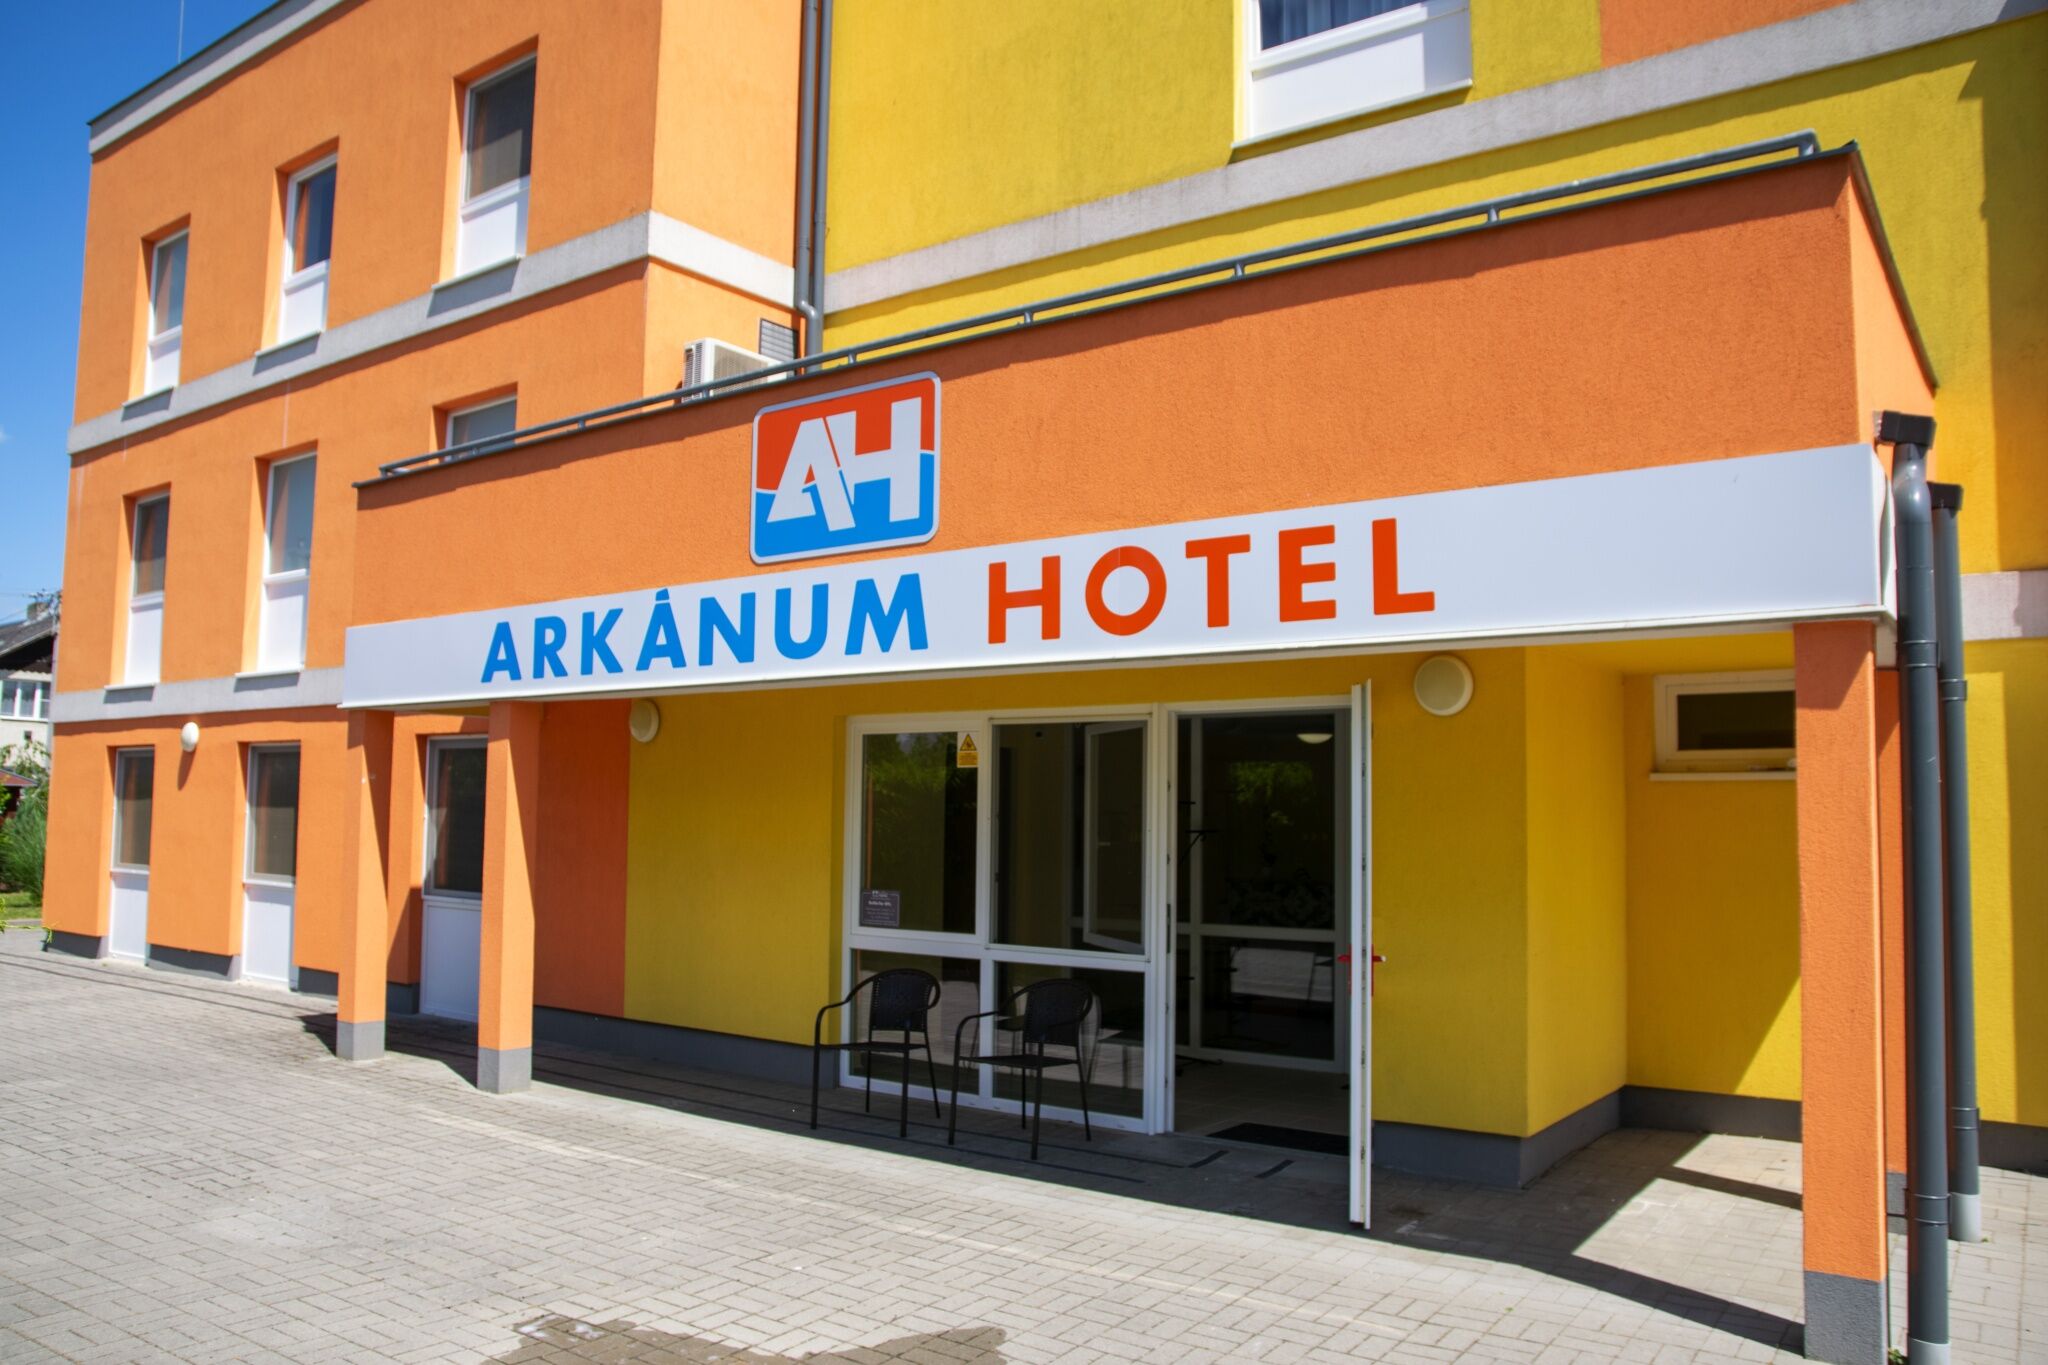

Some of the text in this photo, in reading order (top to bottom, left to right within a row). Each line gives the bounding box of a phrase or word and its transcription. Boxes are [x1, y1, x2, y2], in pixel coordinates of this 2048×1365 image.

[767, 397, 922, 532] AH
[481, 517, 1435, 682] ARKÁNUM HOTEL
